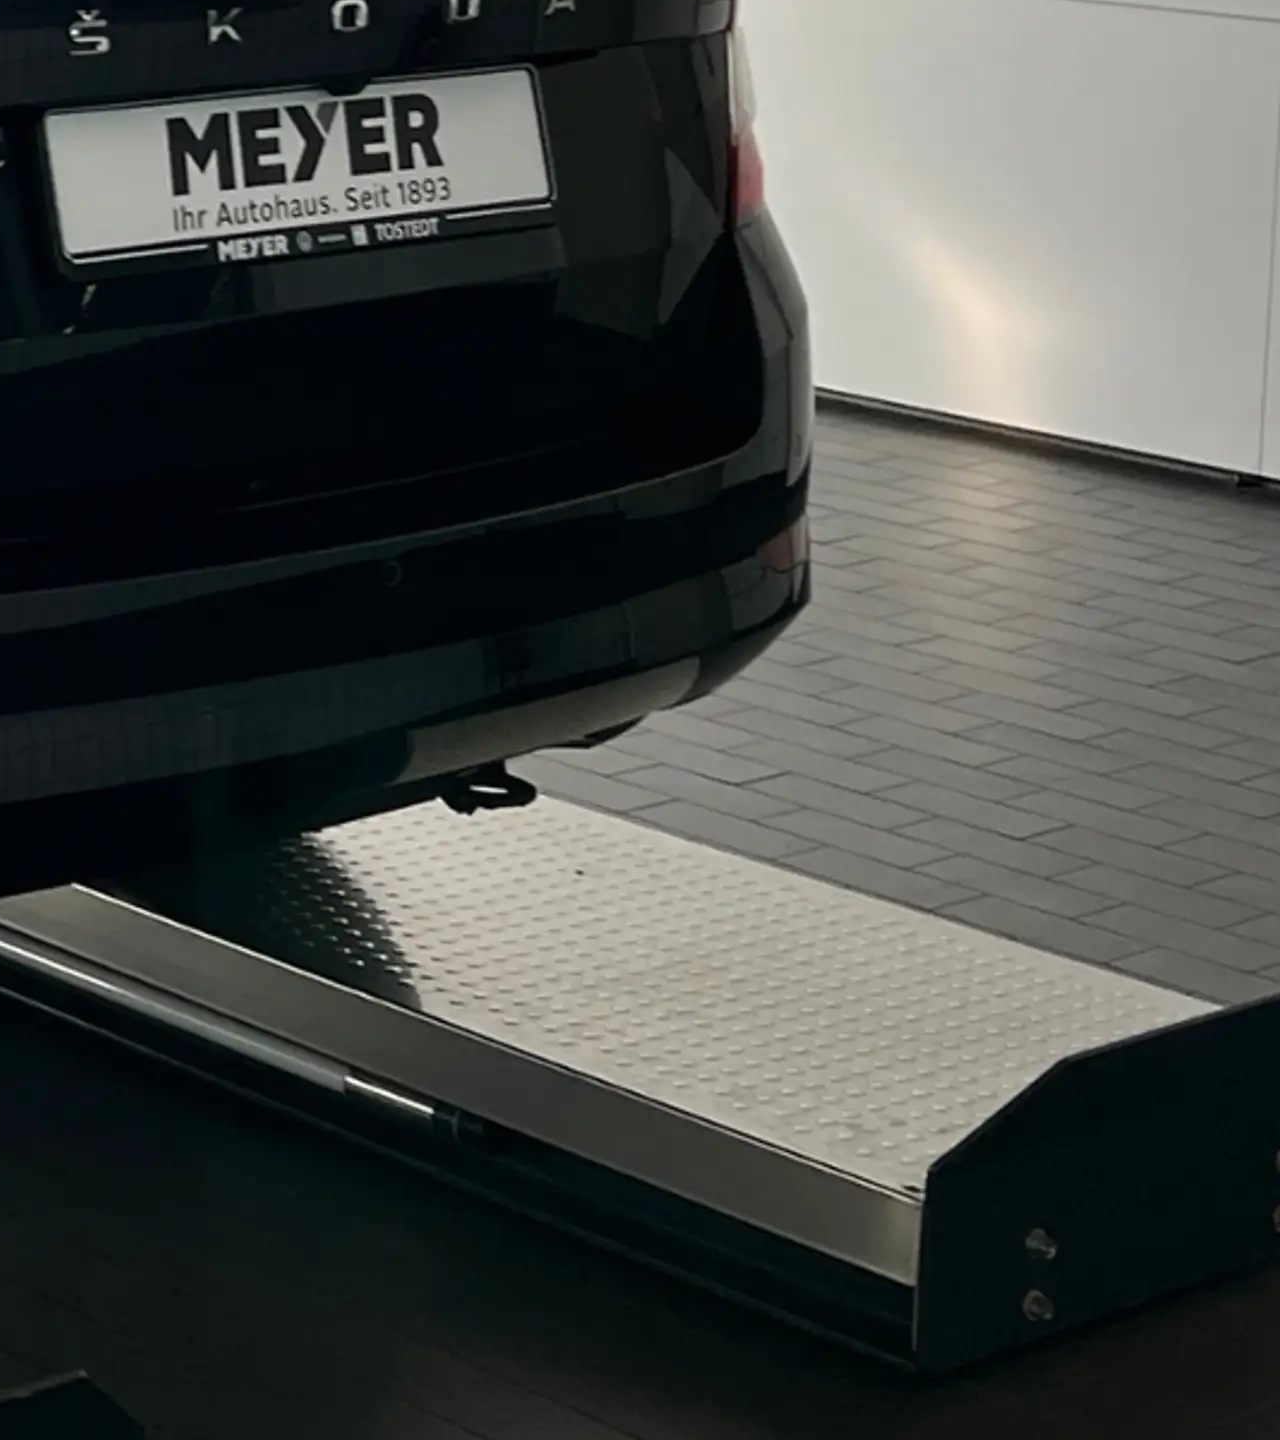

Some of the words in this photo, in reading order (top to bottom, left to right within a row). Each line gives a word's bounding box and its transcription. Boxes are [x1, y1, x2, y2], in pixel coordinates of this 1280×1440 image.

[165, 93, 444, 196] MEYER
[172, 205, 207, 232] Ihr
[216, 194, 339, 227] Autohaus.
[344, 183, 392, 212] Seit
[397, 177, 452, 208] 1893
[216, 234, 289, 262] MEYER
